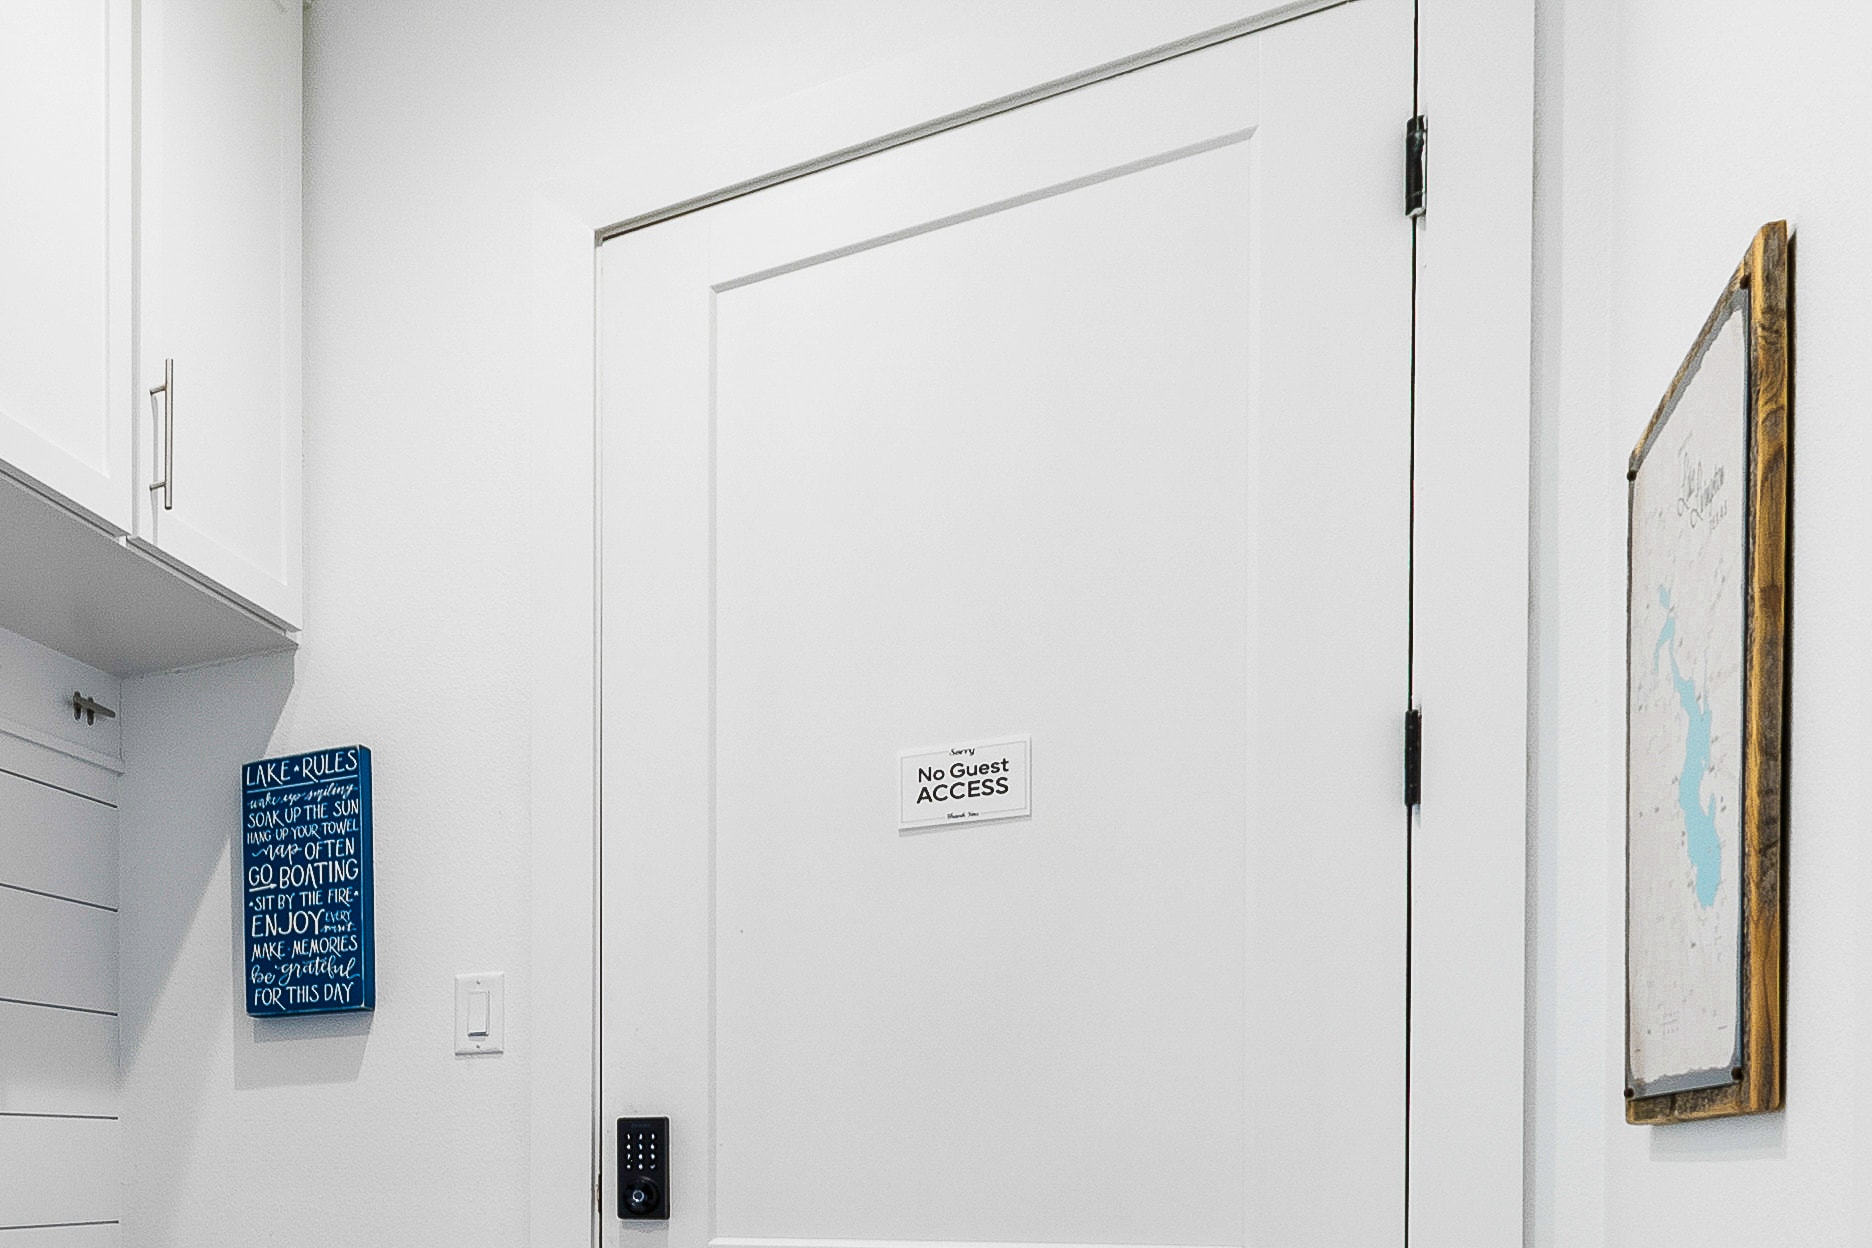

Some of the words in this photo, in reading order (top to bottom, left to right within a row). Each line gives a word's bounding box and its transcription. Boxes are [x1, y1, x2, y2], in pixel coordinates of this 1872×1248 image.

[948, 747, 975, 756] Sorry
[246, 760, 290, 788] LAKE
[302, 750, 358, 783] RULES
[918, 766, 945, 783] No
[949, 757, 1009, 778] Guest
[916, 776, 1009, 804] ACCESS
[247, 810, 284, 829] SOAK
[284, 807, 301, 823] UP
[304, 803, 328, 821] THE
[333, 798, 359, 817] SUN
[247, 830, 272, 845] HANG
[275, 828, 289, 841] UP
[290, 824, 321, 840] YOUR
[322, 818, 359, 835] TOWEL
[251, 843, 302, 865] nap
[304, 837, 355, 860] OFTEN
[248, 864, 273, 887] GO
[279, 858, 359, 889] BOATING
[254, 895, 274, 911] SIT
[277, 893, 295, 909] BY
[299, 890, 323, 907] THE
[328, 886, 354, 907] FIRE
[251, 908, 325, 938] ENJOY
[325, 909, 352, 923] EVERY
[251, 941, 285, 962] MAKE
[291, 934, 358, 959] MEMORIES
[249, 964, 276, 984] be
[278, 954, 360, 986] grateful
[254, 988, 286, 1010] FOR
[286, 984, 319, 1004] THIS
[324, 981, 354, 1004] DAY
